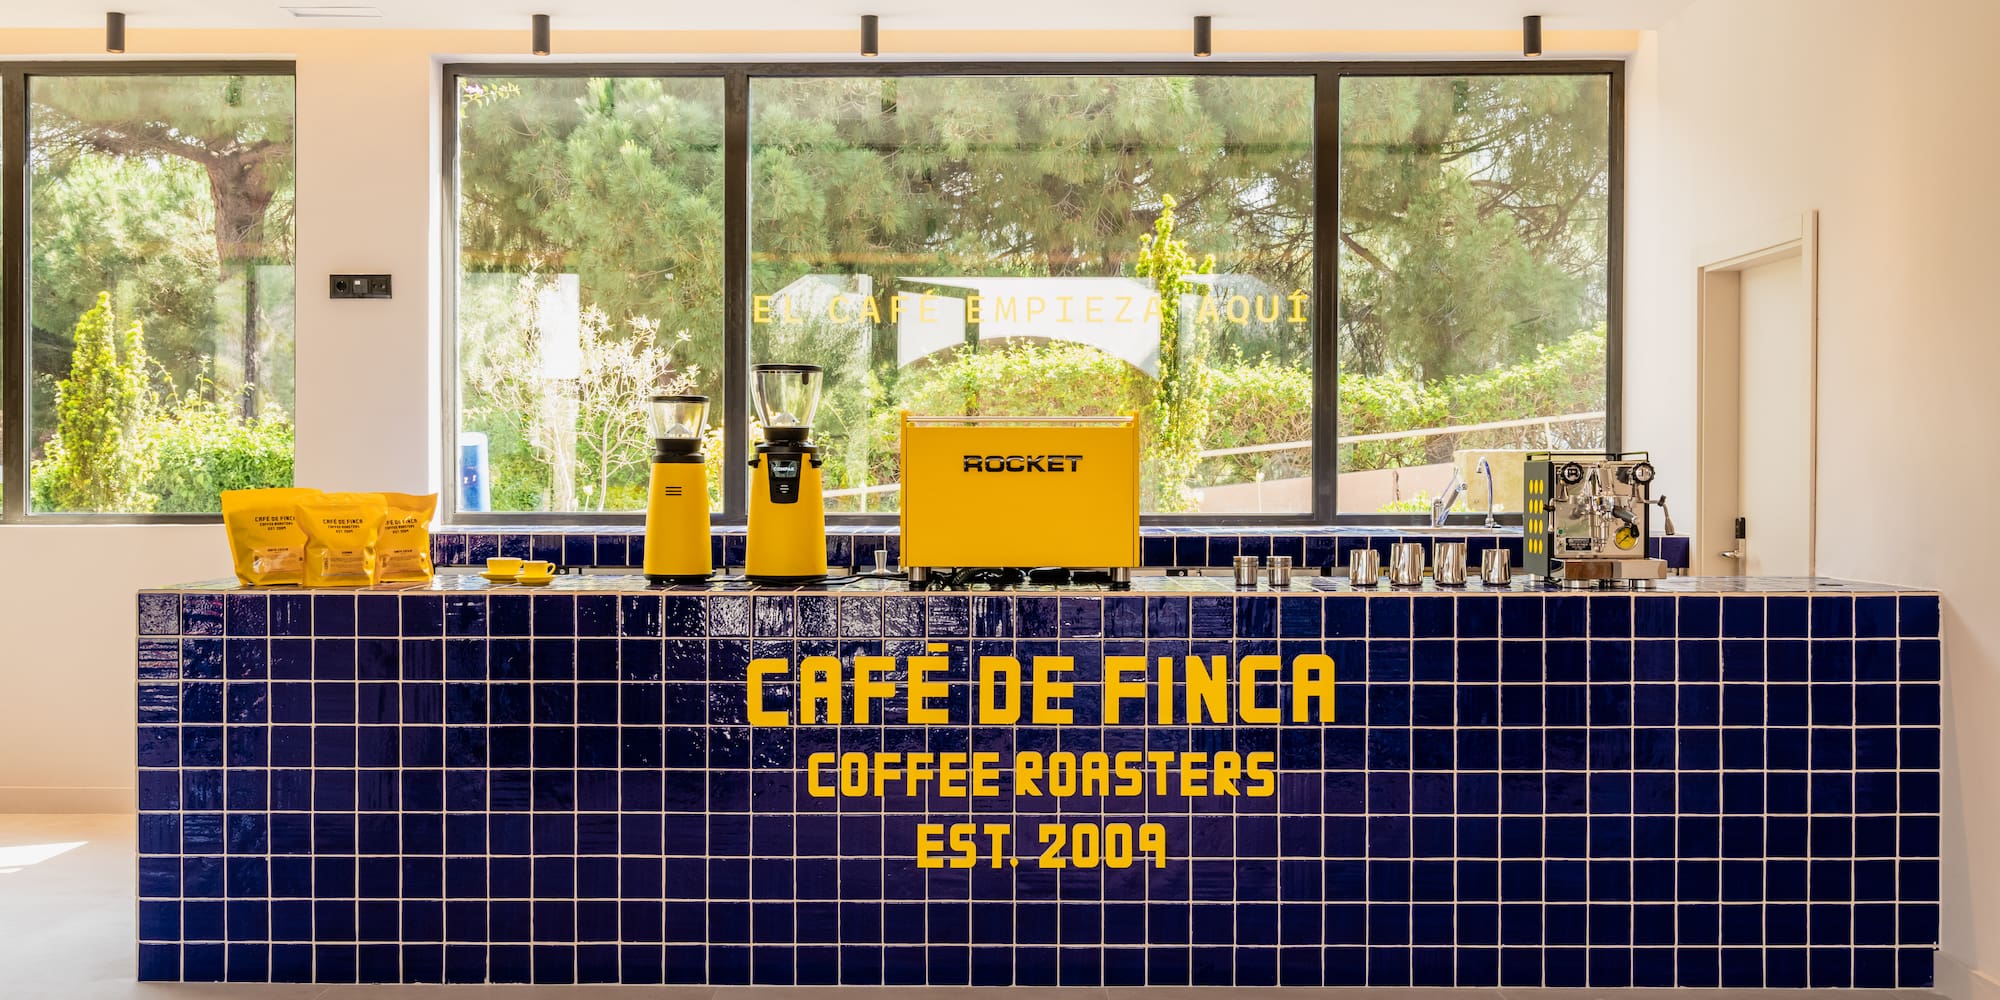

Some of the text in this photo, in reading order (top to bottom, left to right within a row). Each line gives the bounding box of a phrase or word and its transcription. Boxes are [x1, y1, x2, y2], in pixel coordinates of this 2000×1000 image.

[753, 288, 1308, 326] EL CAFÉ EMPIEZA AQUÍ
[963, 455, 1083, 473] ROCKET
[747, 643, 1336, 726] CAFÉ DE FINCA
[807, 752, 1275, 797] COFFEE ROASTERS
[917, 823, 1166, 869] EST. 2009
